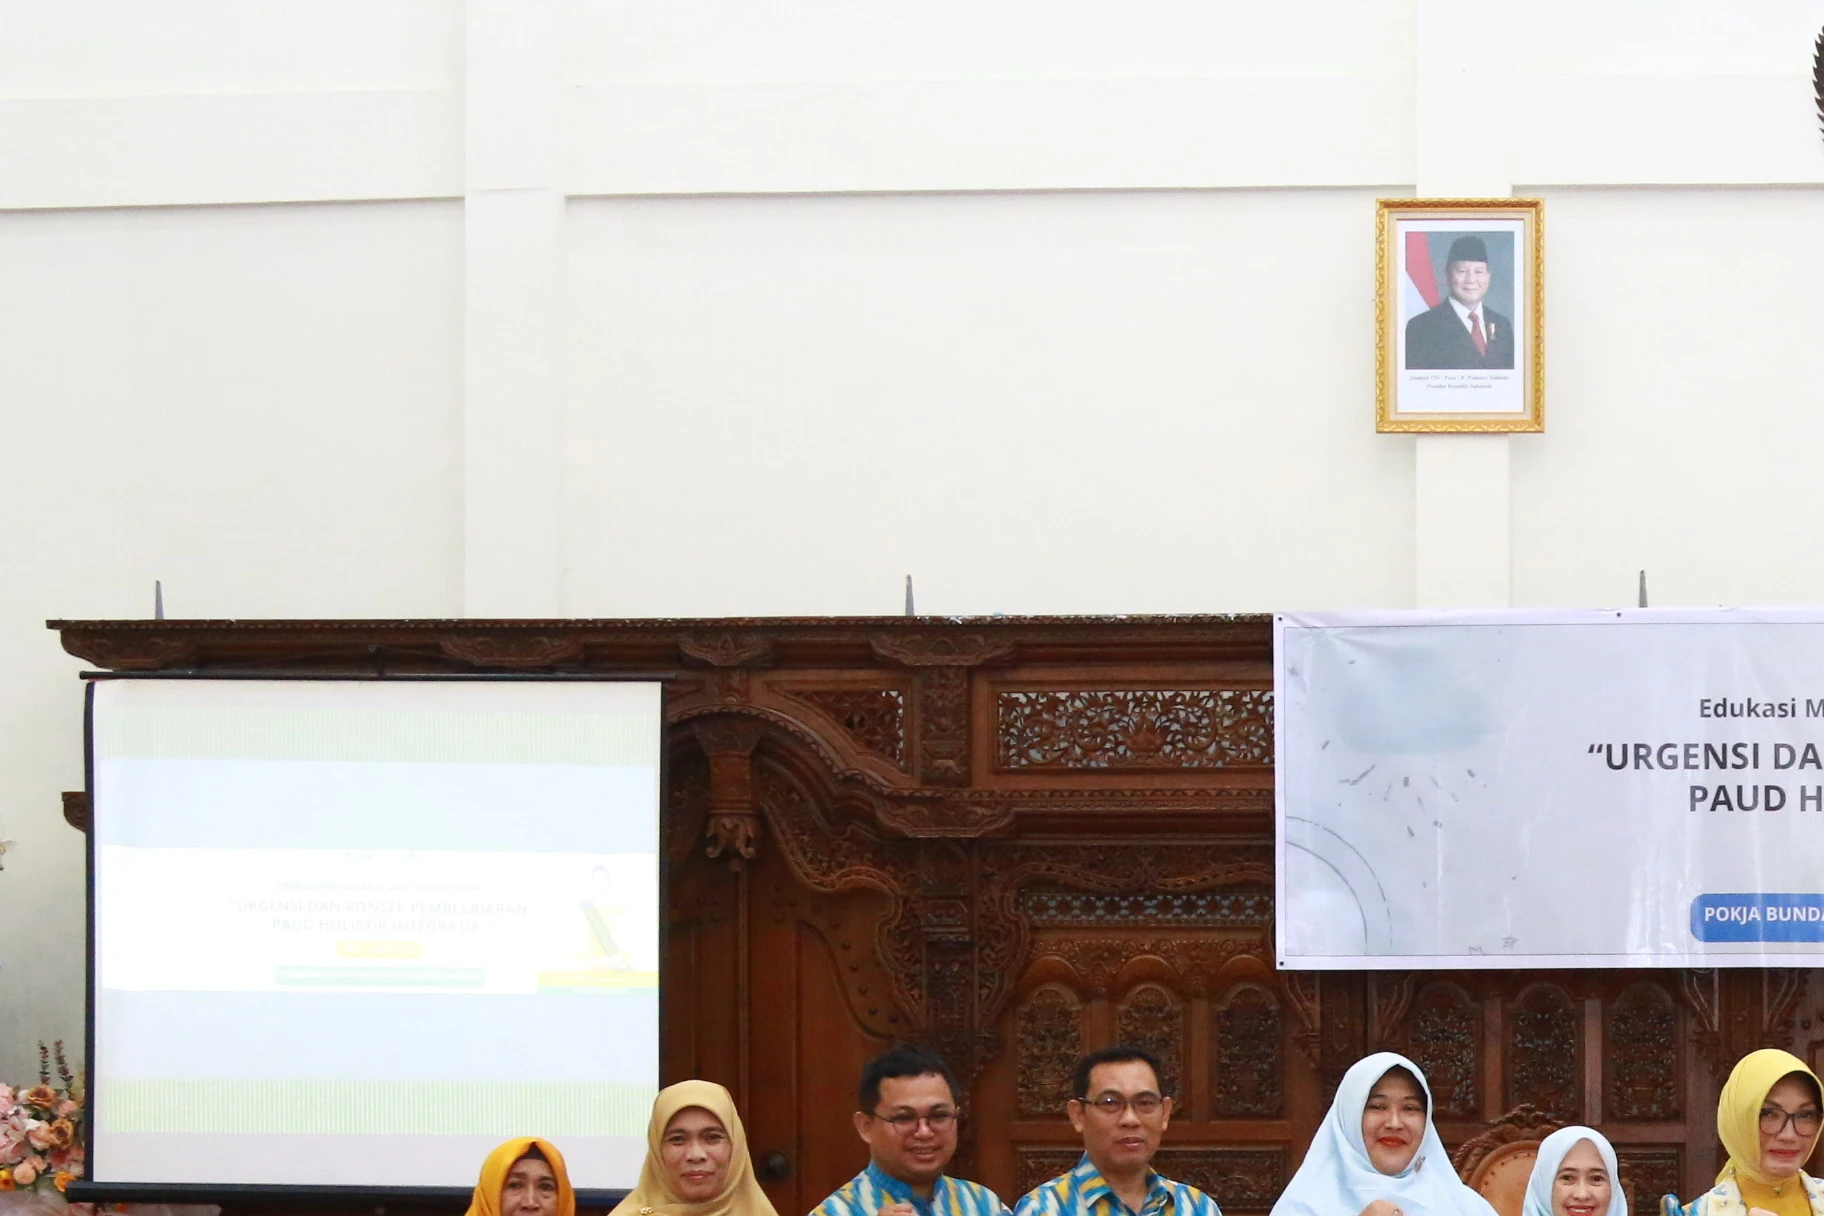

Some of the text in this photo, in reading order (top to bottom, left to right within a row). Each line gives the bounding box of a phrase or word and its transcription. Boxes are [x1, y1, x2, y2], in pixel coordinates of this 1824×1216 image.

[1699, 697, 1797, 718] Edukasi
[1588, 742, 1759, 770] “URGENSI
[1689, 785, 1786, 812] PAUD
[308, 900, 341, 912] DAN
[346, 901, 405, 914] KONSEP
[411, 902, 527, 917] PEMBELAJARAN
[1704, 906, 1761, 925] POKJA
[272, 918, 314, 930] PAUD
[319, 919, 387, 931] HOLISTIK
